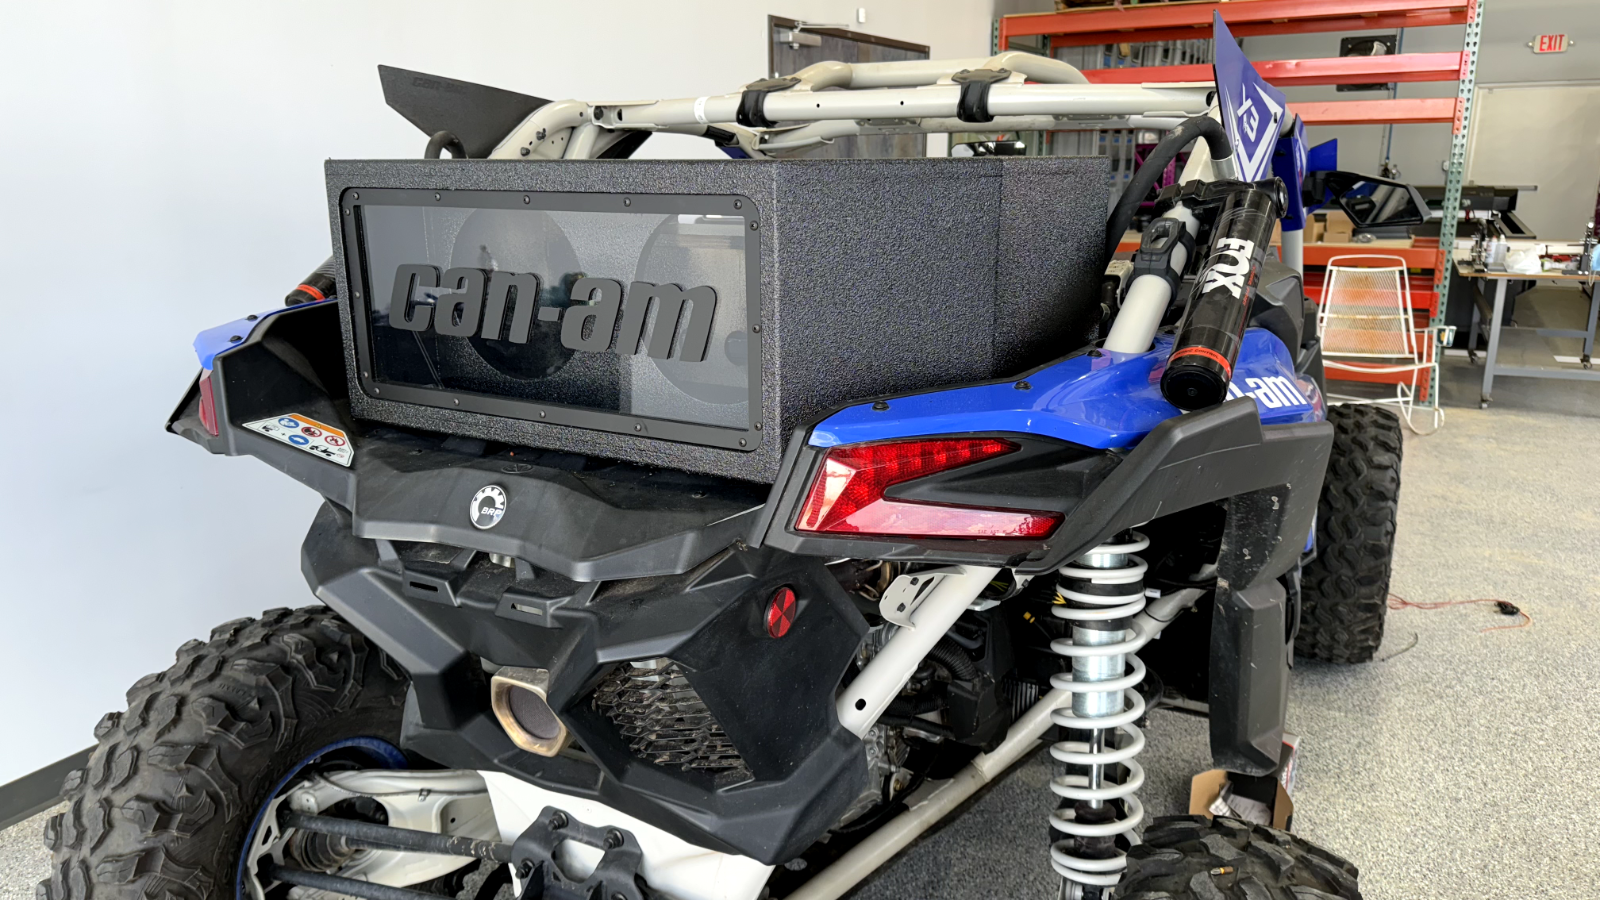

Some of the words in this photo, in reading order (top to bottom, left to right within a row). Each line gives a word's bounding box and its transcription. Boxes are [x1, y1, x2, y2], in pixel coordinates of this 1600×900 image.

[1539, 34, 1565, 51] EXIT
[1202, 237, 1255, 299] FOX
[389, 264, 718, 363] can-am
[480, 506, 503, 517] BRP
